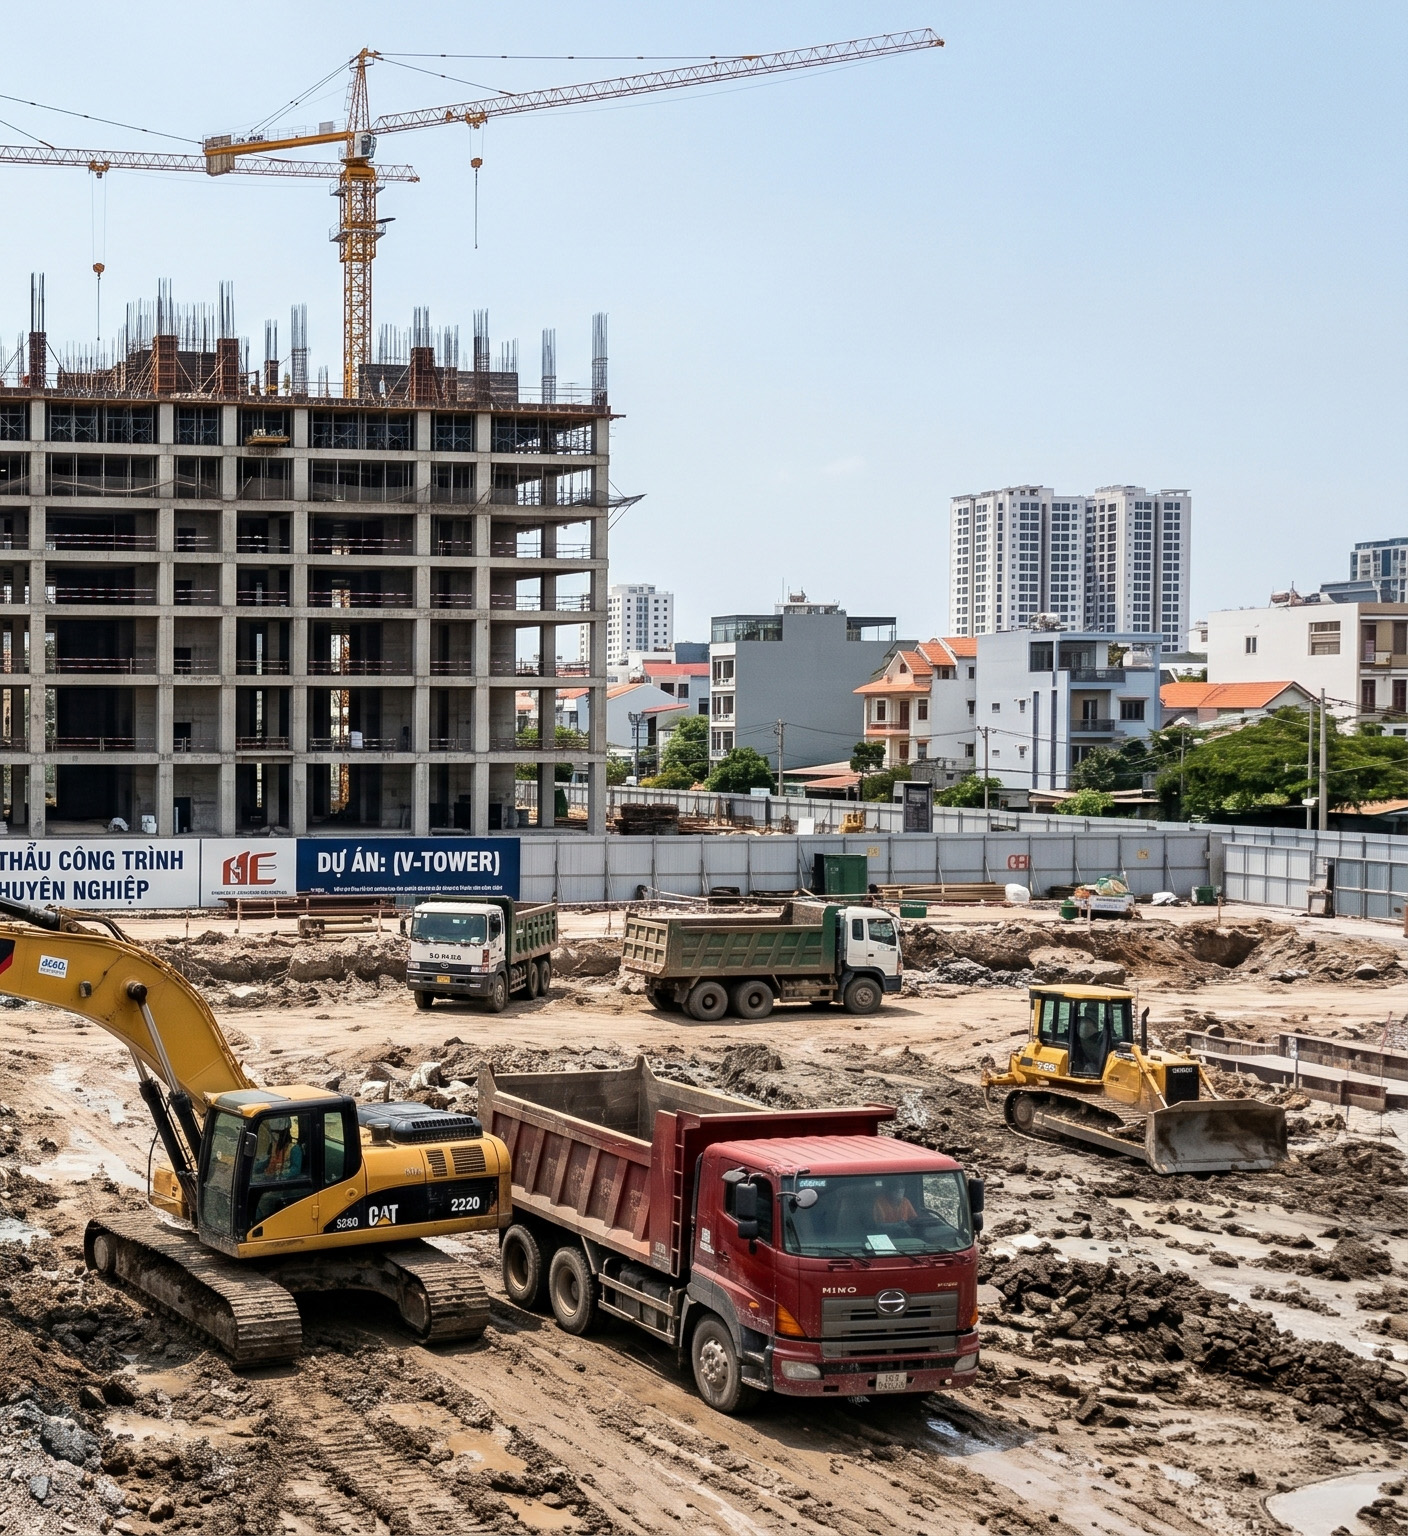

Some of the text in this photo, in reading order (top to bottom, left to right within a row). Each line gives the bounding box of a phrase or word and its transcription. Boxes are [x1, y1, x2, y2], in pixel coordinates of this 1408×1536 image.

[59, 846, 115, 871] CÔNG
[122, 845, 184, 870] TRÌNH
[318, 846, 500, 878] DỰ ÁN: (V-TOWER)
[73, 875, 149, 905] NGHIỆP
[368, 1204, 399, 1227] CAT
[451, 1196, 480, 1212] 2220
